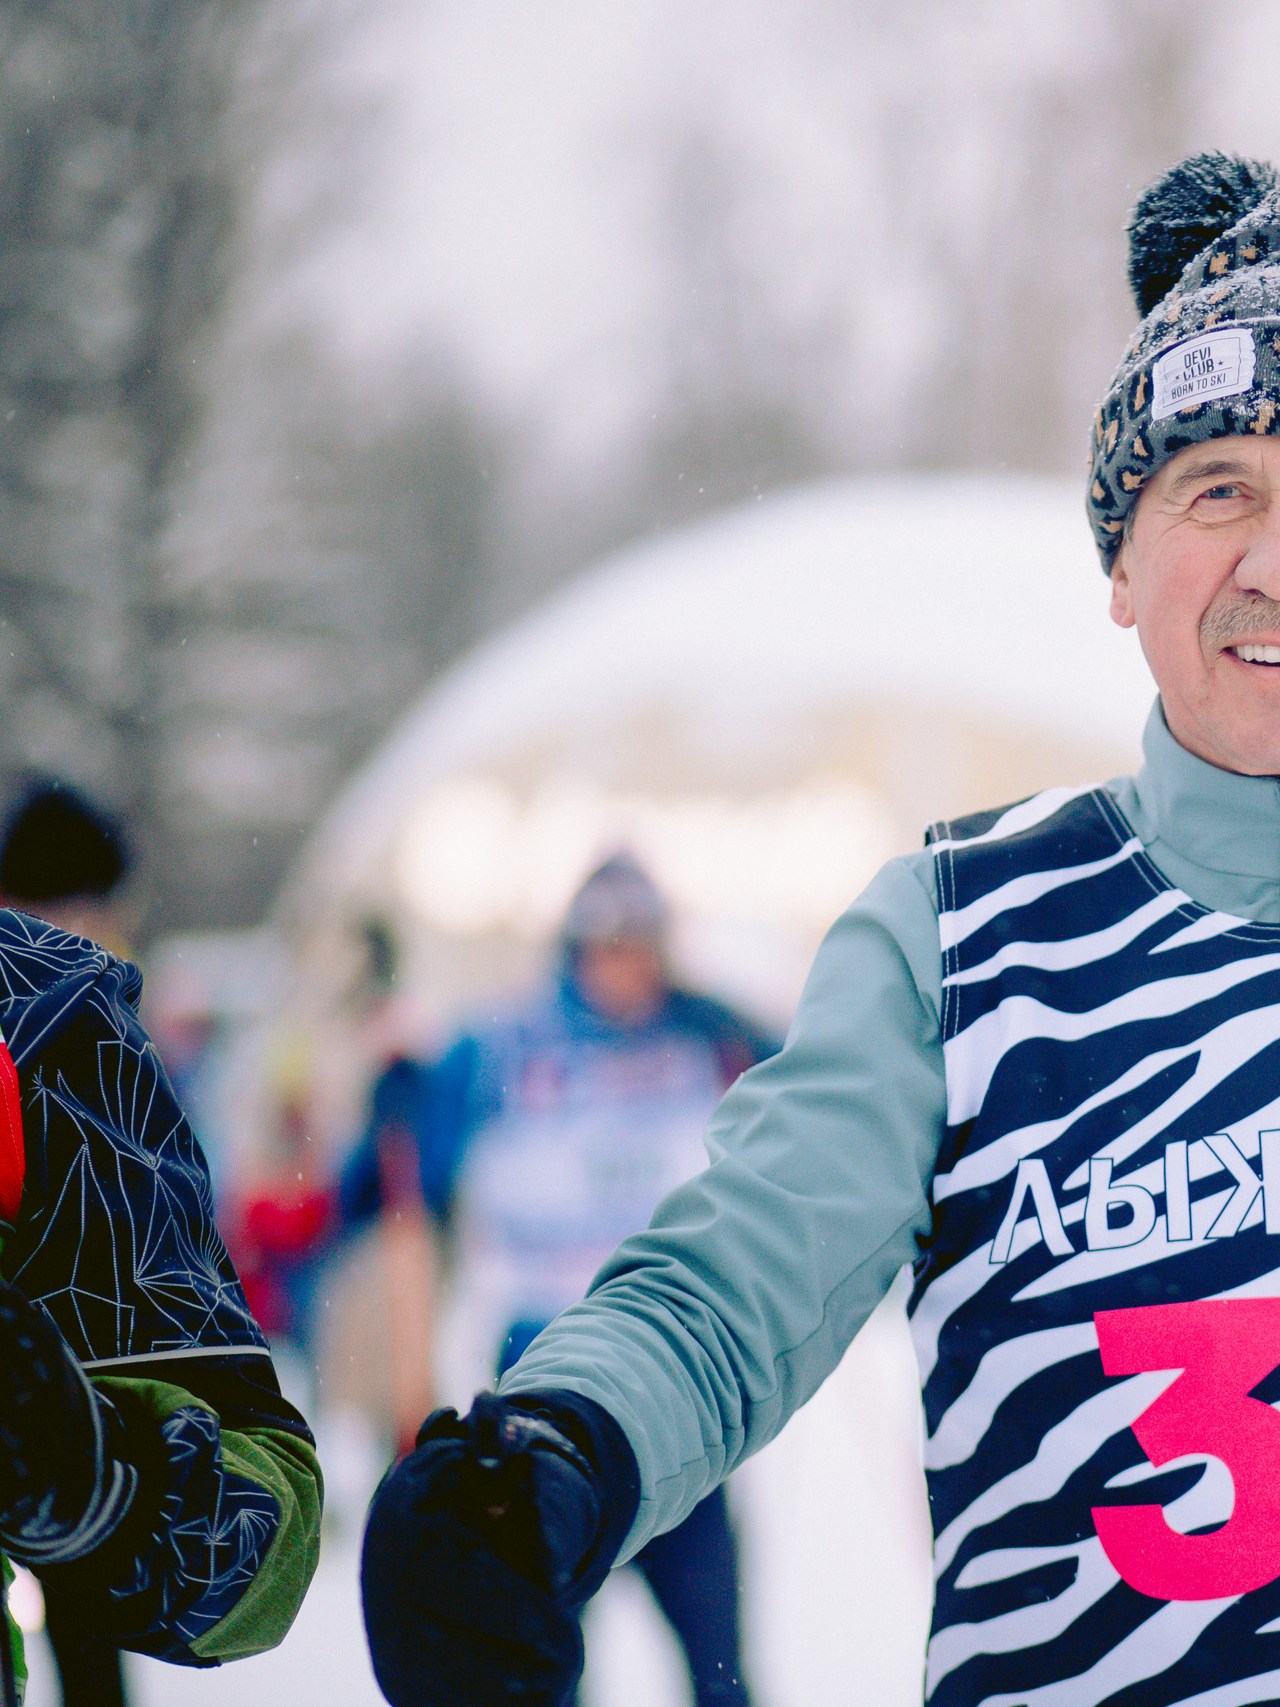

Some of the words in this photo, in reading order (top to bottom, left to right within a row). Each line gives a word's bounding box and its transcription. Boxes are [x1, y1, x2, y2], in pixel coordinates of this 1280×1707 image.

[1184, 346, 1211, 369] DEVI
[1183, 358, 1214, 381] CLUB
[1171, 381, 1194, 400] BORN
[1196, 377, 1208, 390] TO
[1210, 372, 1226, 387] SKI
